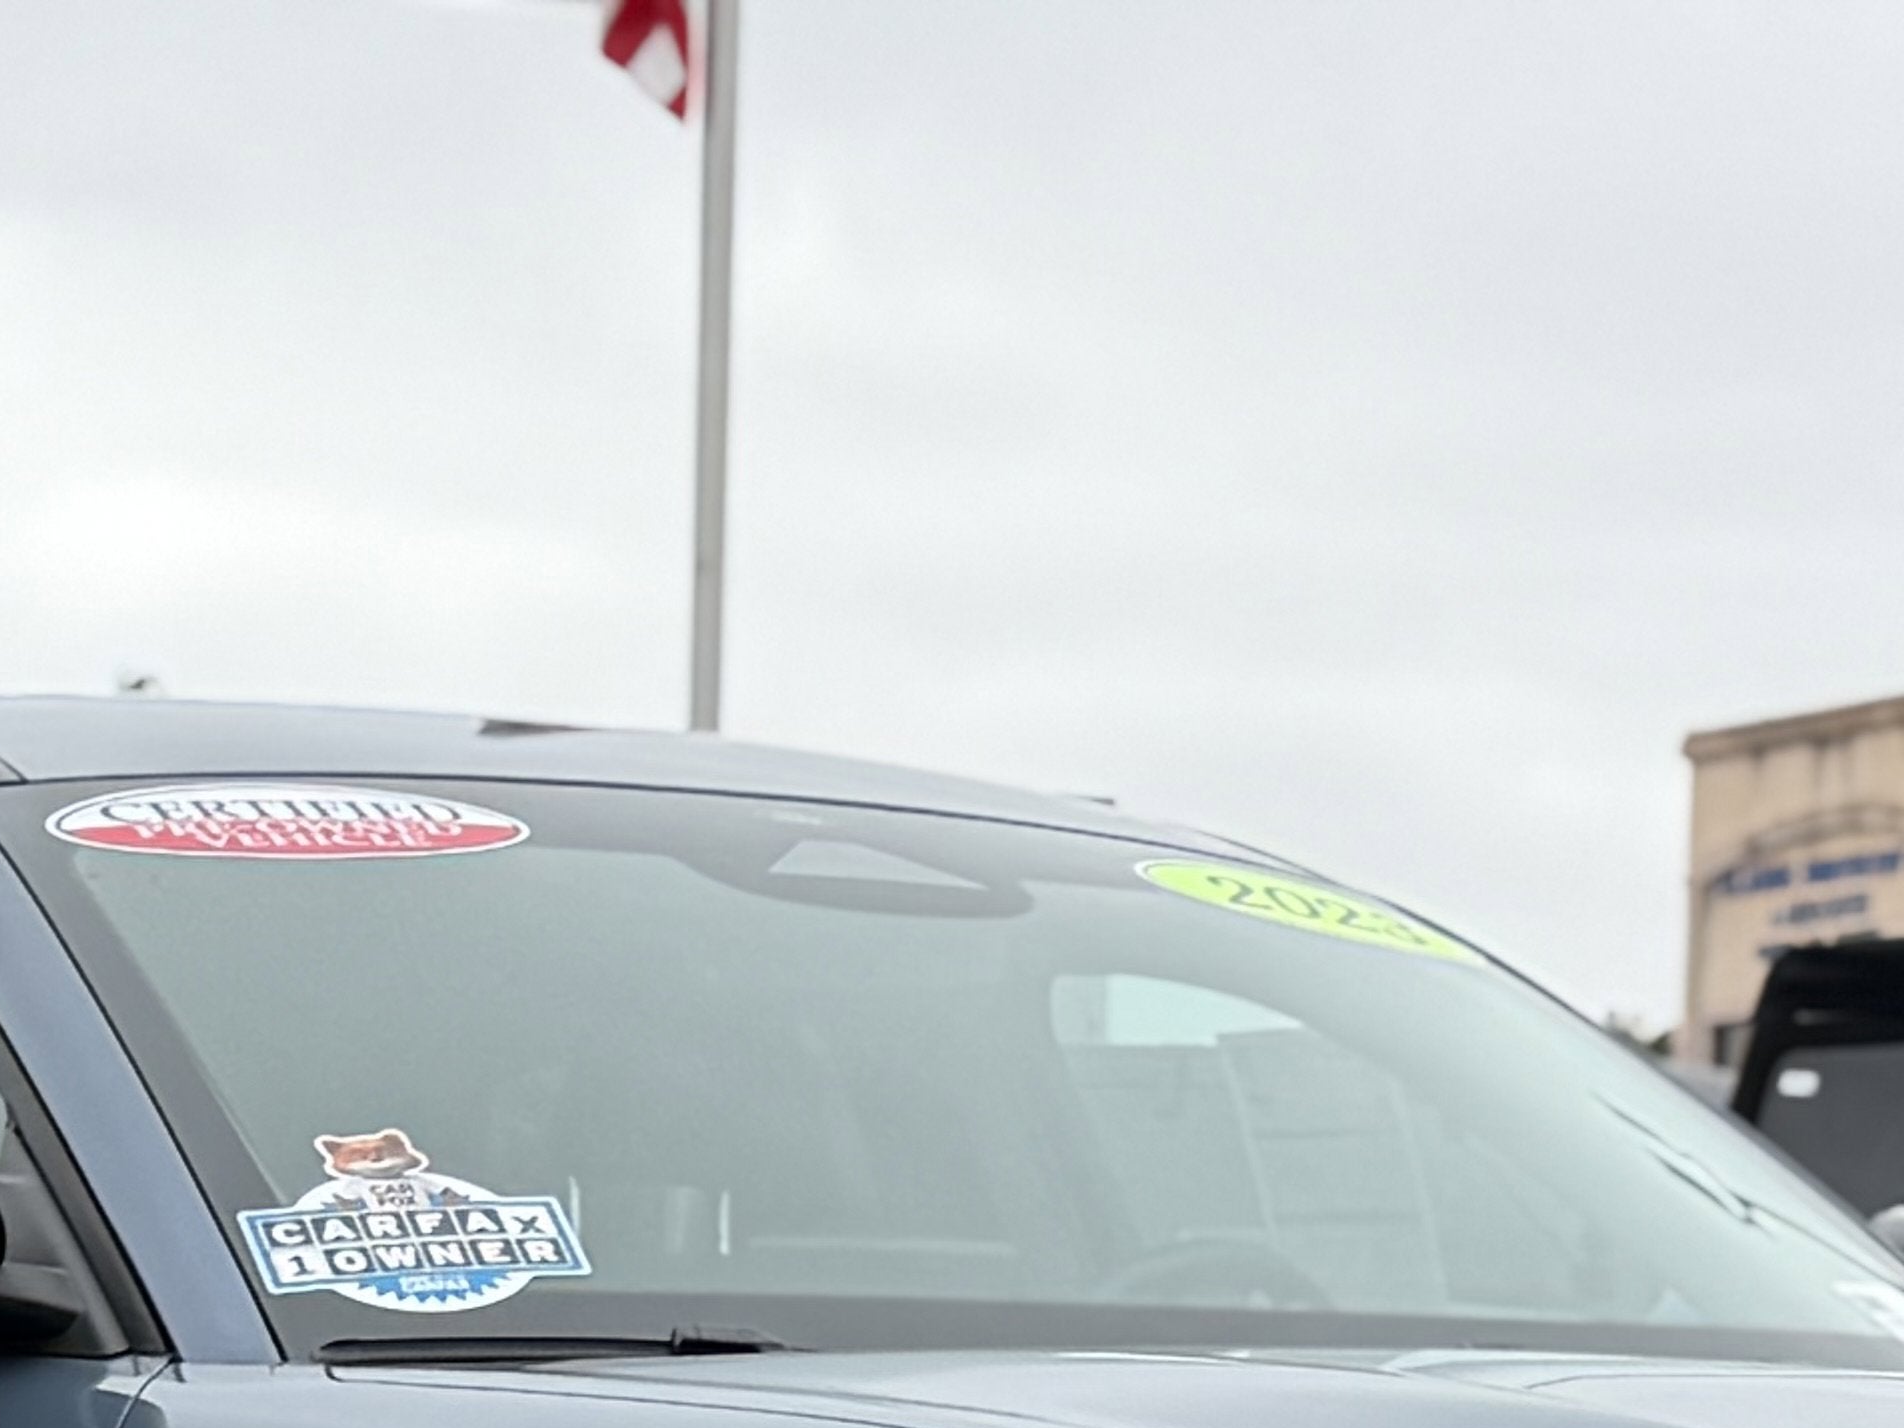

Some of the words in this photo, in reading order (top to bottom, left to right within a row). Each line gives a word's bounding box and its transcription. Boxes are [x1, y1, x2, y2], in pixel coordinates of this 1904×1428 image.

[100, 799, 462, 824] CERTIFIED
[271, 1210, 551, 1246] CARFAX
[286, 1253, 318, 1277] 1
[332, 1241, 562, 1274] OWNER
